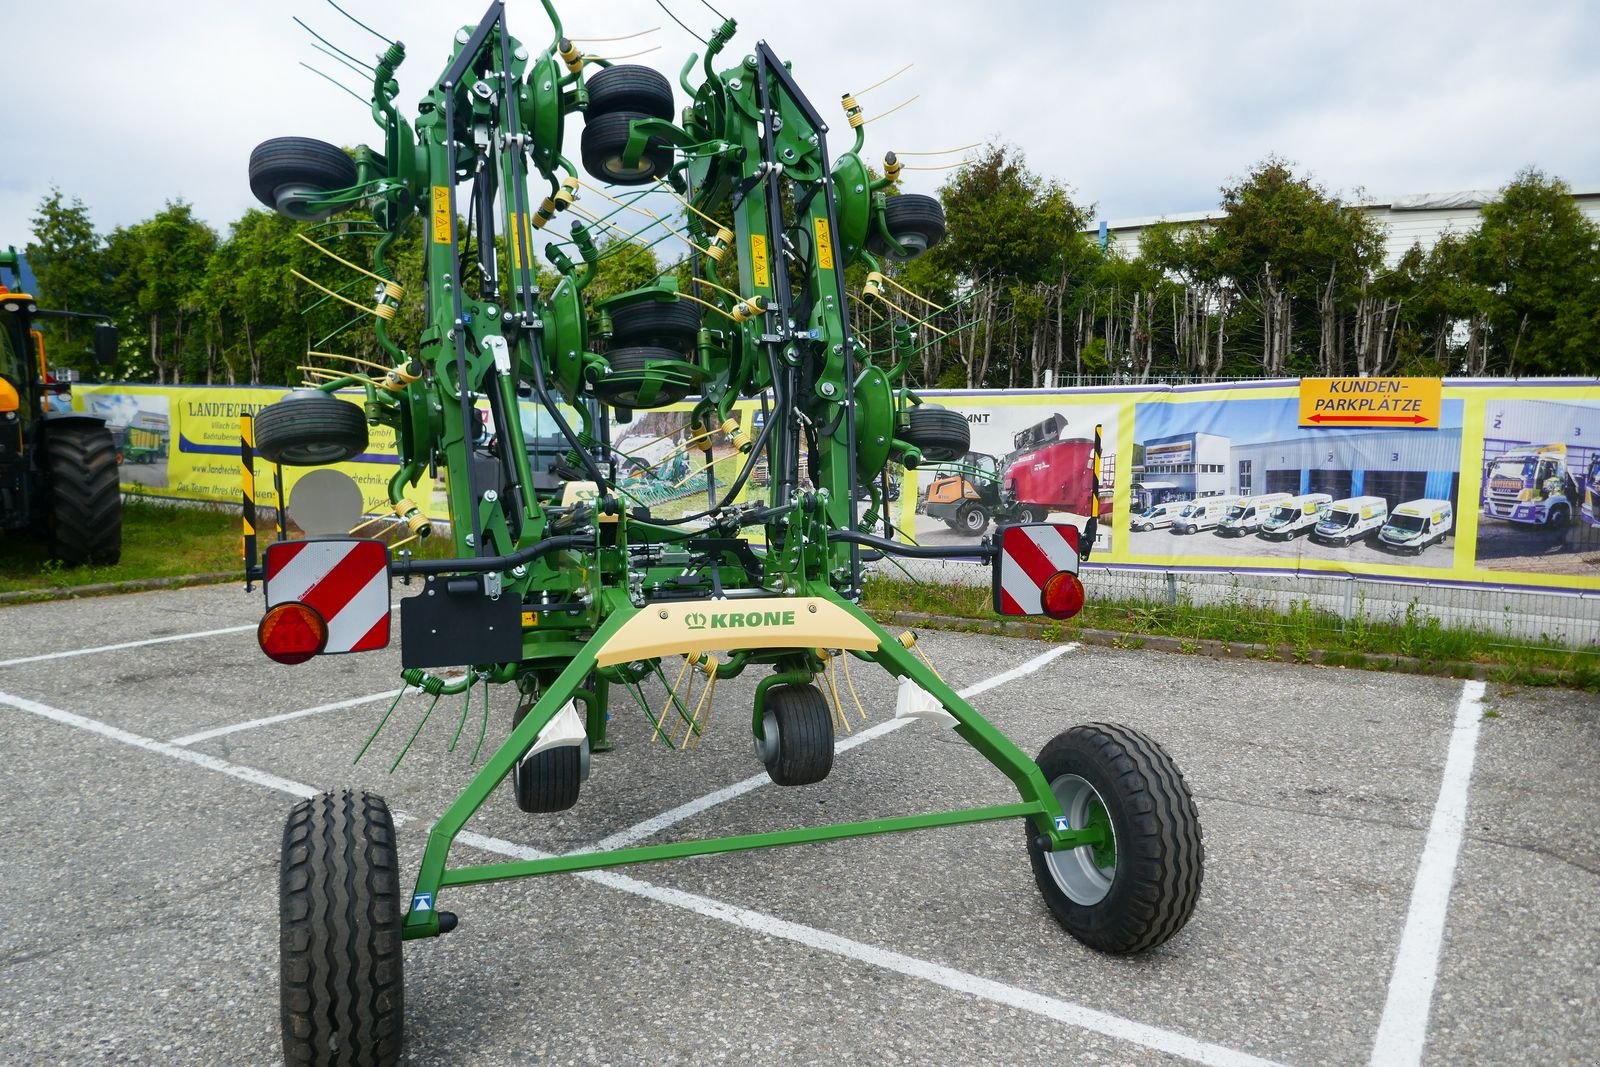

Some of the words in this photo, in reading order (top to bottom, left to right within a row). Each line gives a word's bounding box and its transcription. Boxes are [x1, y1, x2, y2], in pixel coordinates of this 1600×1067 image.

[1329, 380, 1409, 393] KUNDEN-
[188, 402, 268, 418] LANDTECHN
[1314, 395, 1423, 411] PARKPLÄTZE
[966, 413, 991, 423] ANT
[710, 610, 796, 629] KRONE
